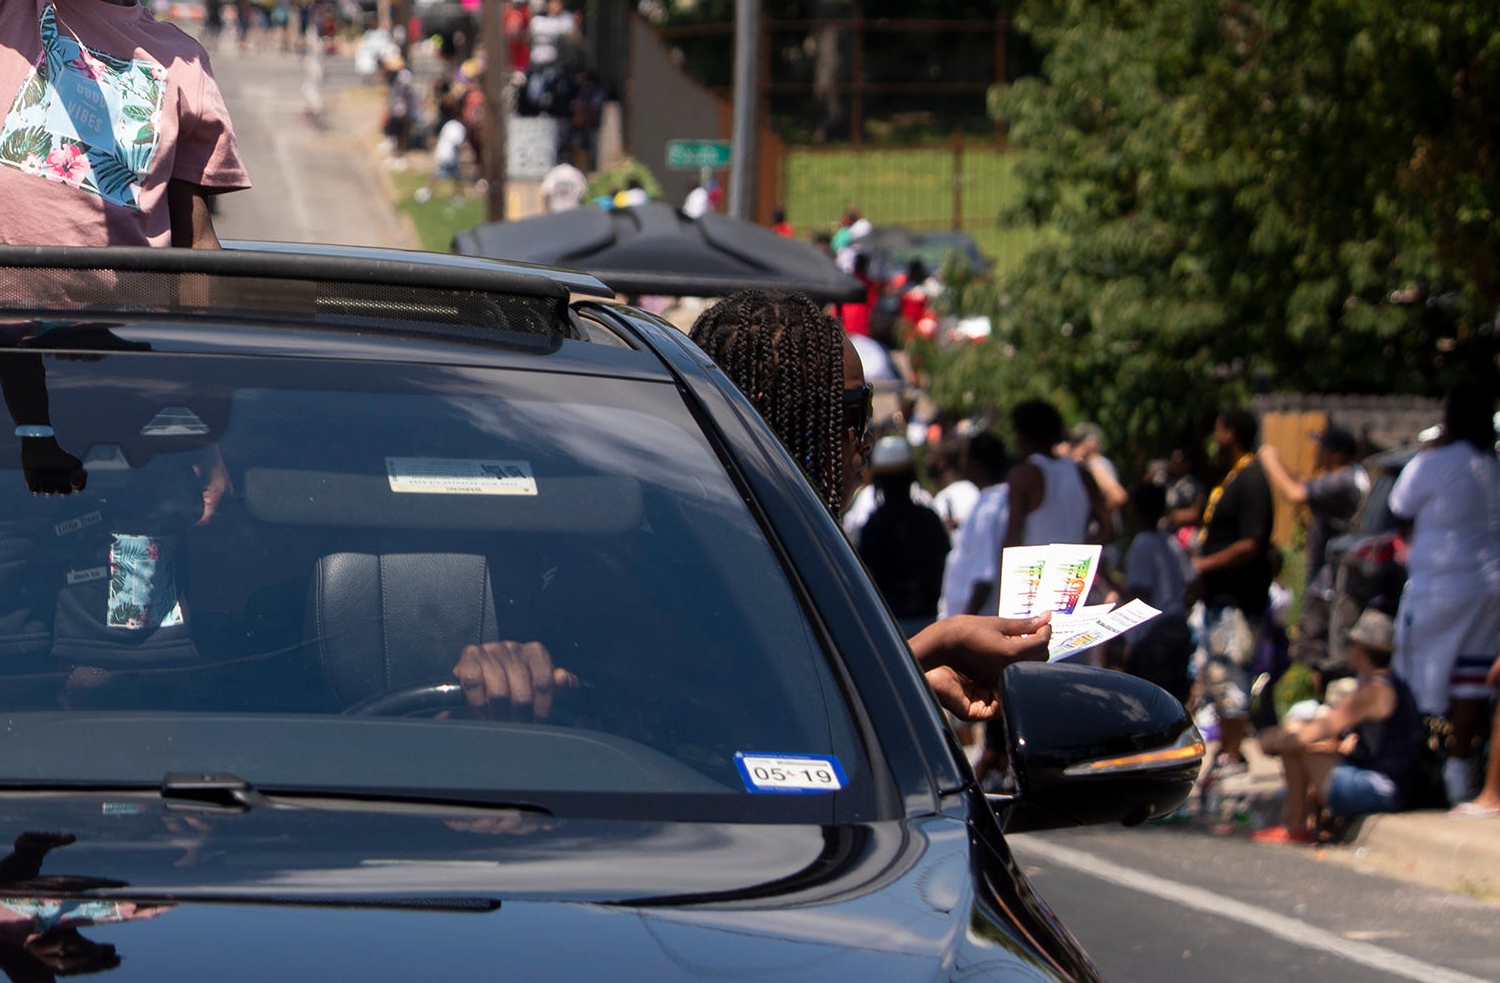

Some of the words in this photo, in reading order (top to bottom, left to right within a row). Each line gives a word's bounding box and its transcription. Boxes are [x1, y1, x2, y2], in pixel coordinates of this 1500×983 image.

[68, 100, 103, 132] VIBES
[754, 766, 786, 781] 05
[799, 769, 832, 783] 19
